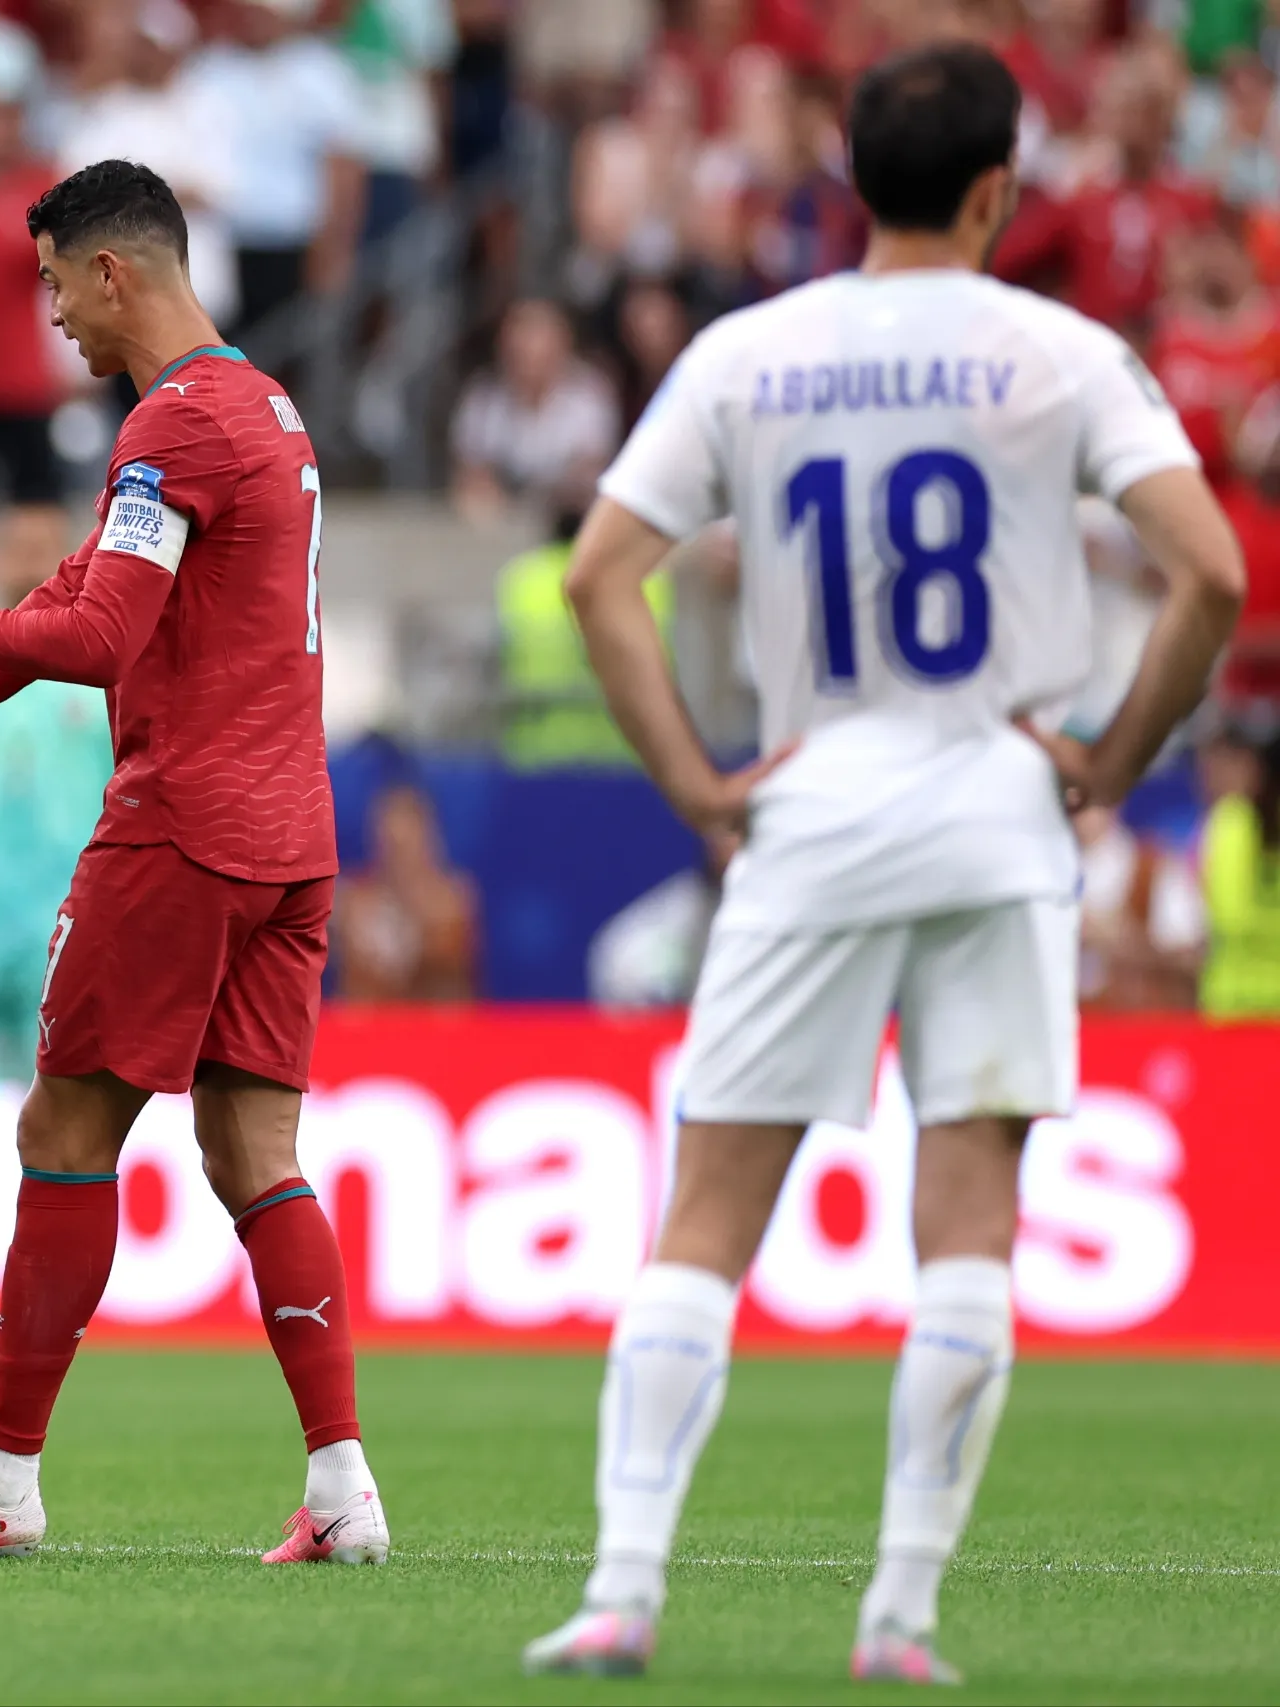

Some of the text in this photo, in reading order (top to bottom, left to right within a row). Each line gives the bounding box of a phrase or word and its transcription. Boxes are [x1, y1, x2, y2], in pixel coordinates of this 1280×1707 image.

[752, 358, 1014, 413] ABDULLAEV
[118, 502, 164, 521] FOOTBALL
[113, 514, 163, 534] UNITES
[107, 528, 163, 548] the World
[115, 541, 136, 550] FIFA
[777, 447, 991, 694] 18
